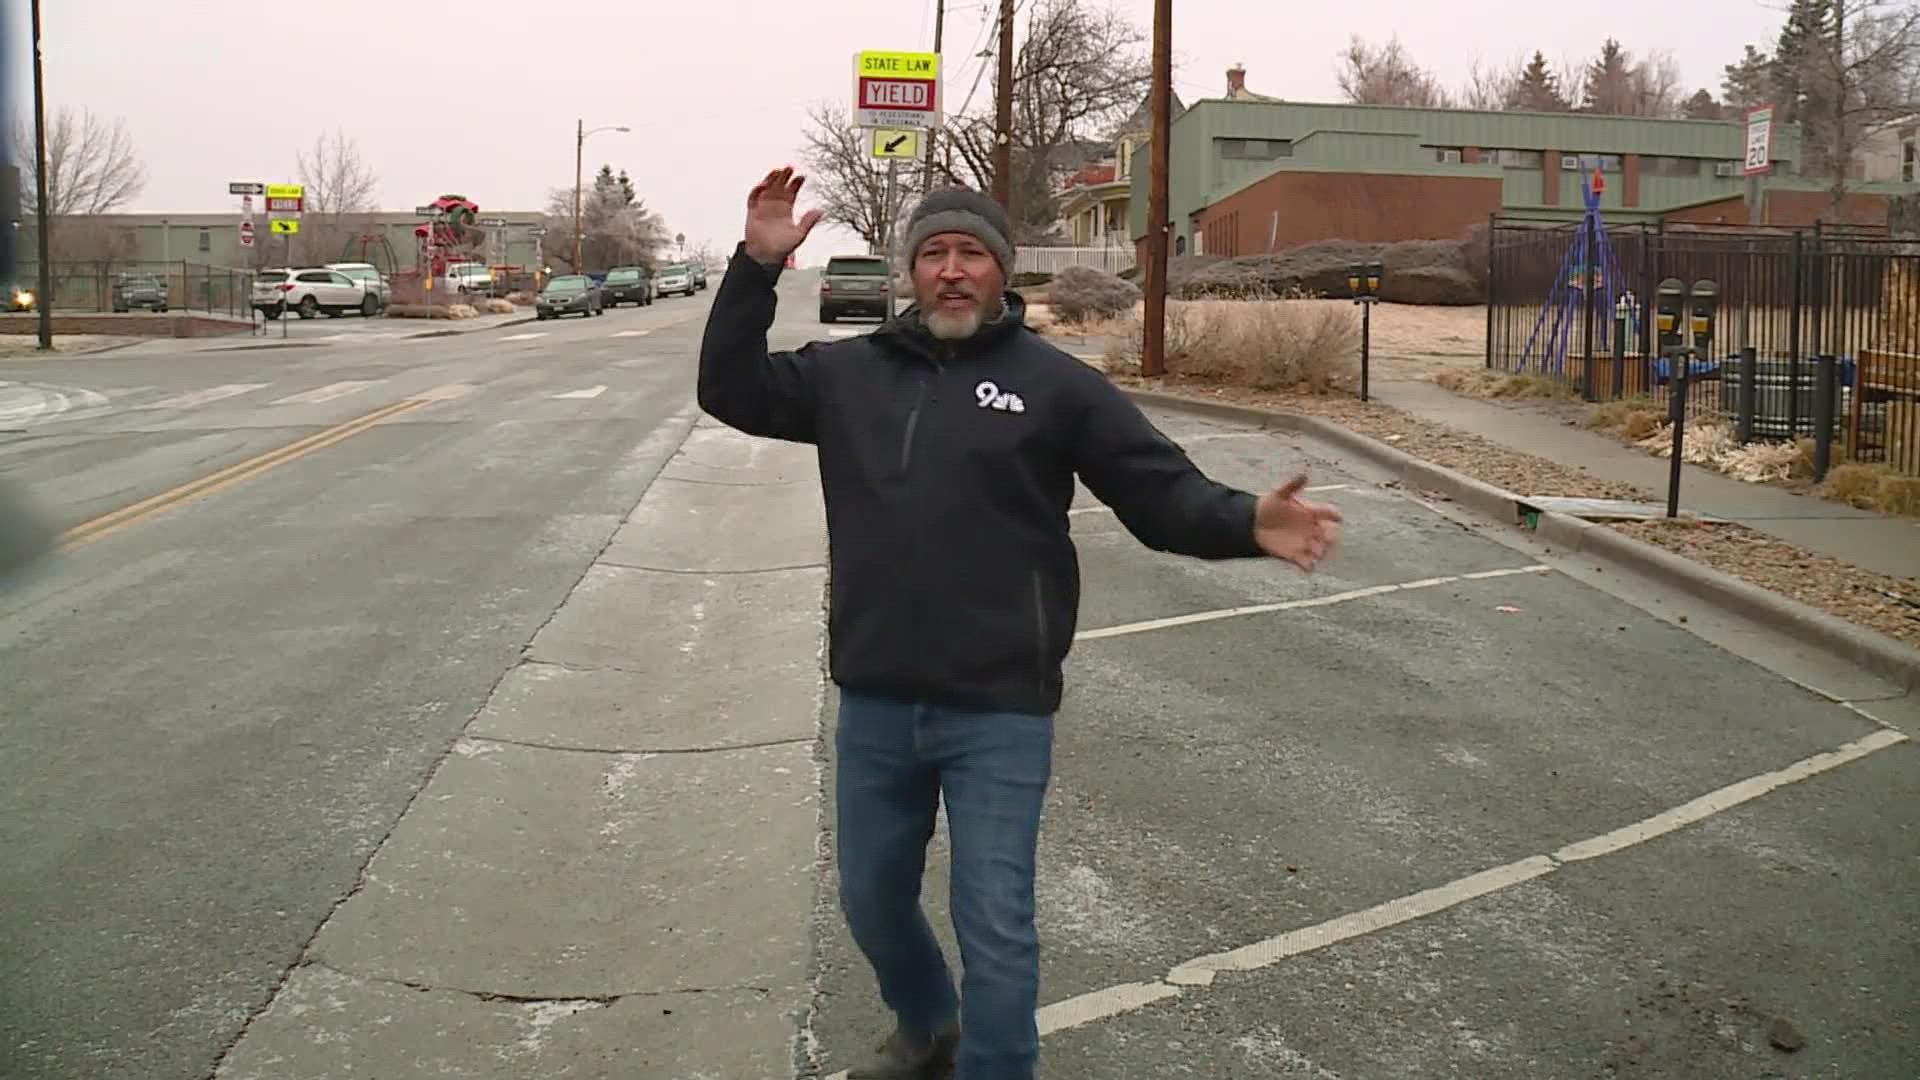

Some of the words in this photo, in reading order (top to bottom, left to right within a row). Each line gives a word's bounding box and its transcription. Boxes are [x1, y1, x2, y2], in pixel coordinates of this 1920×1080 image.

[865, 57, 901, 71] STATE
[906, 59, 932, 72] LAW
[871, 83, 924, 104] YIELD
[1749, 145, 1766, 166] 20
